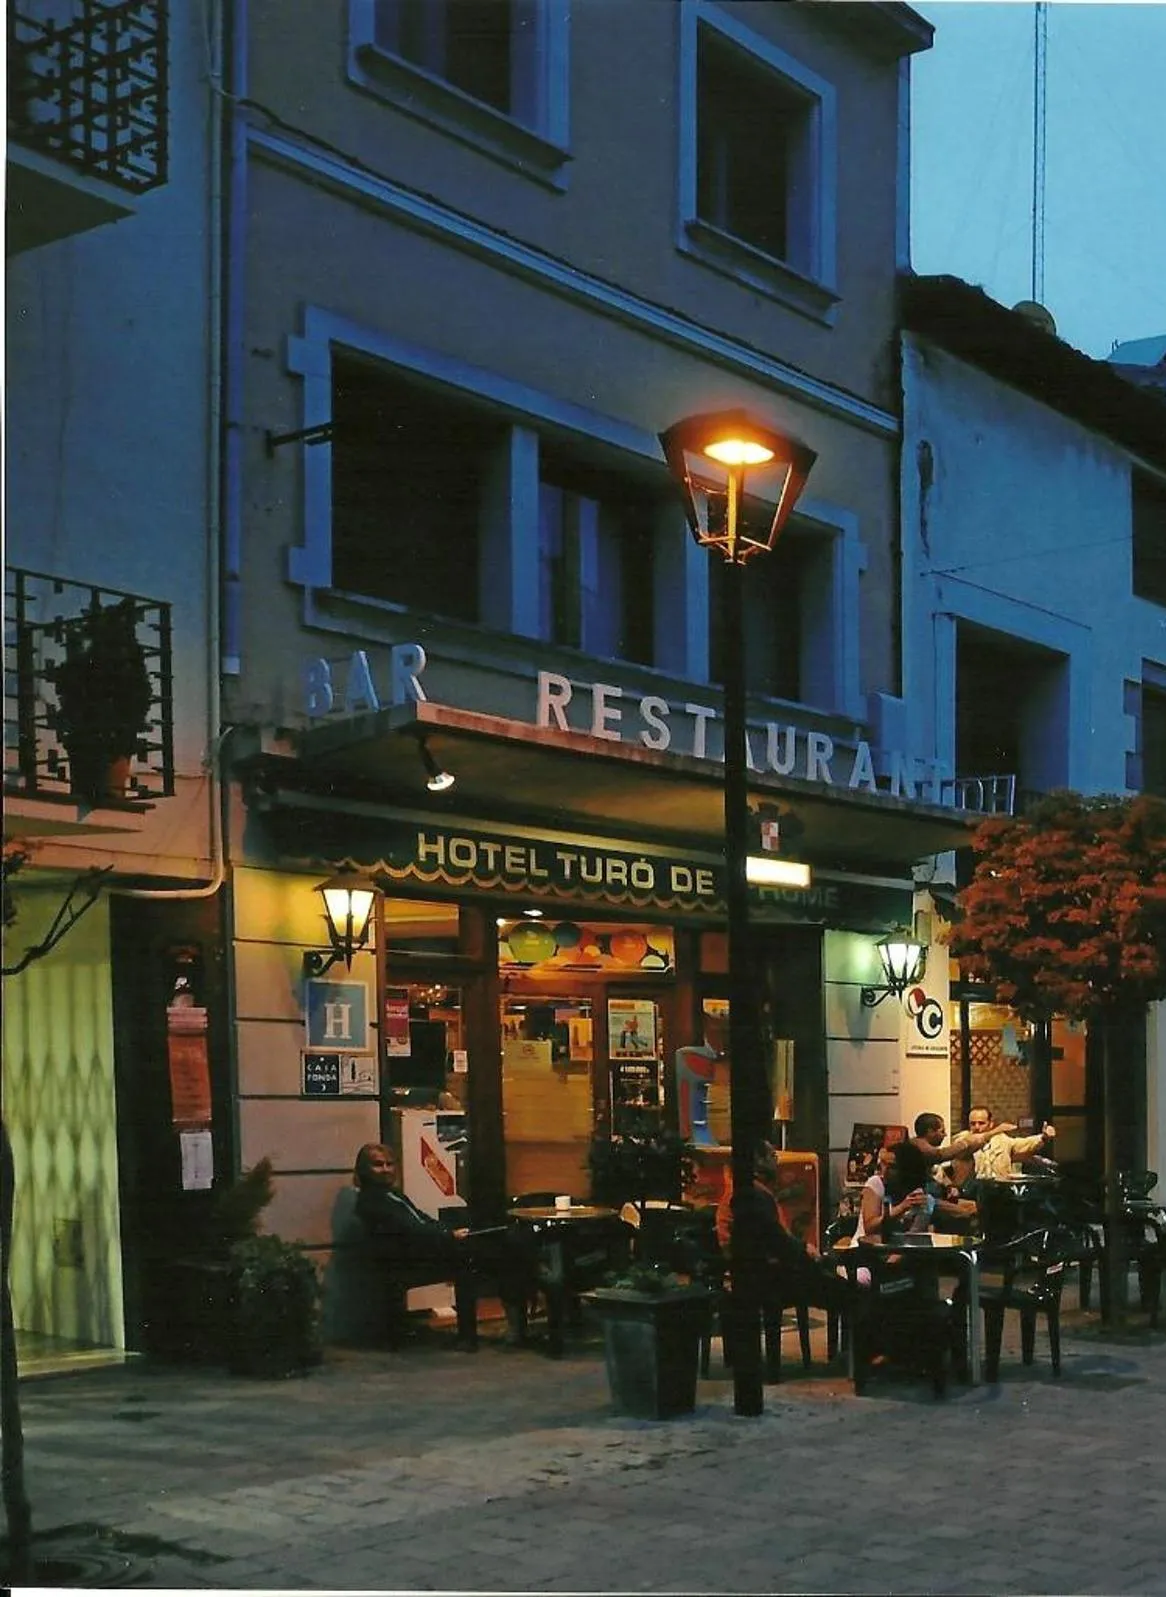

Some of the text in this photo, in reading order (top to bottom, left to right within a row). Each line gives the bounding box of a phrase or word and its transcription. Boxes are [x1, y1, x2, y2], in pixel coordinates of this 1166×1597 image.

[303, 643, 427, 717] BAR
[417, 833, 549, 878] HOTEL
[556, 850, 655, 889] TURÓ
[671, 865, 715, 895] DE
[323, 1002, 352, 1040] H
